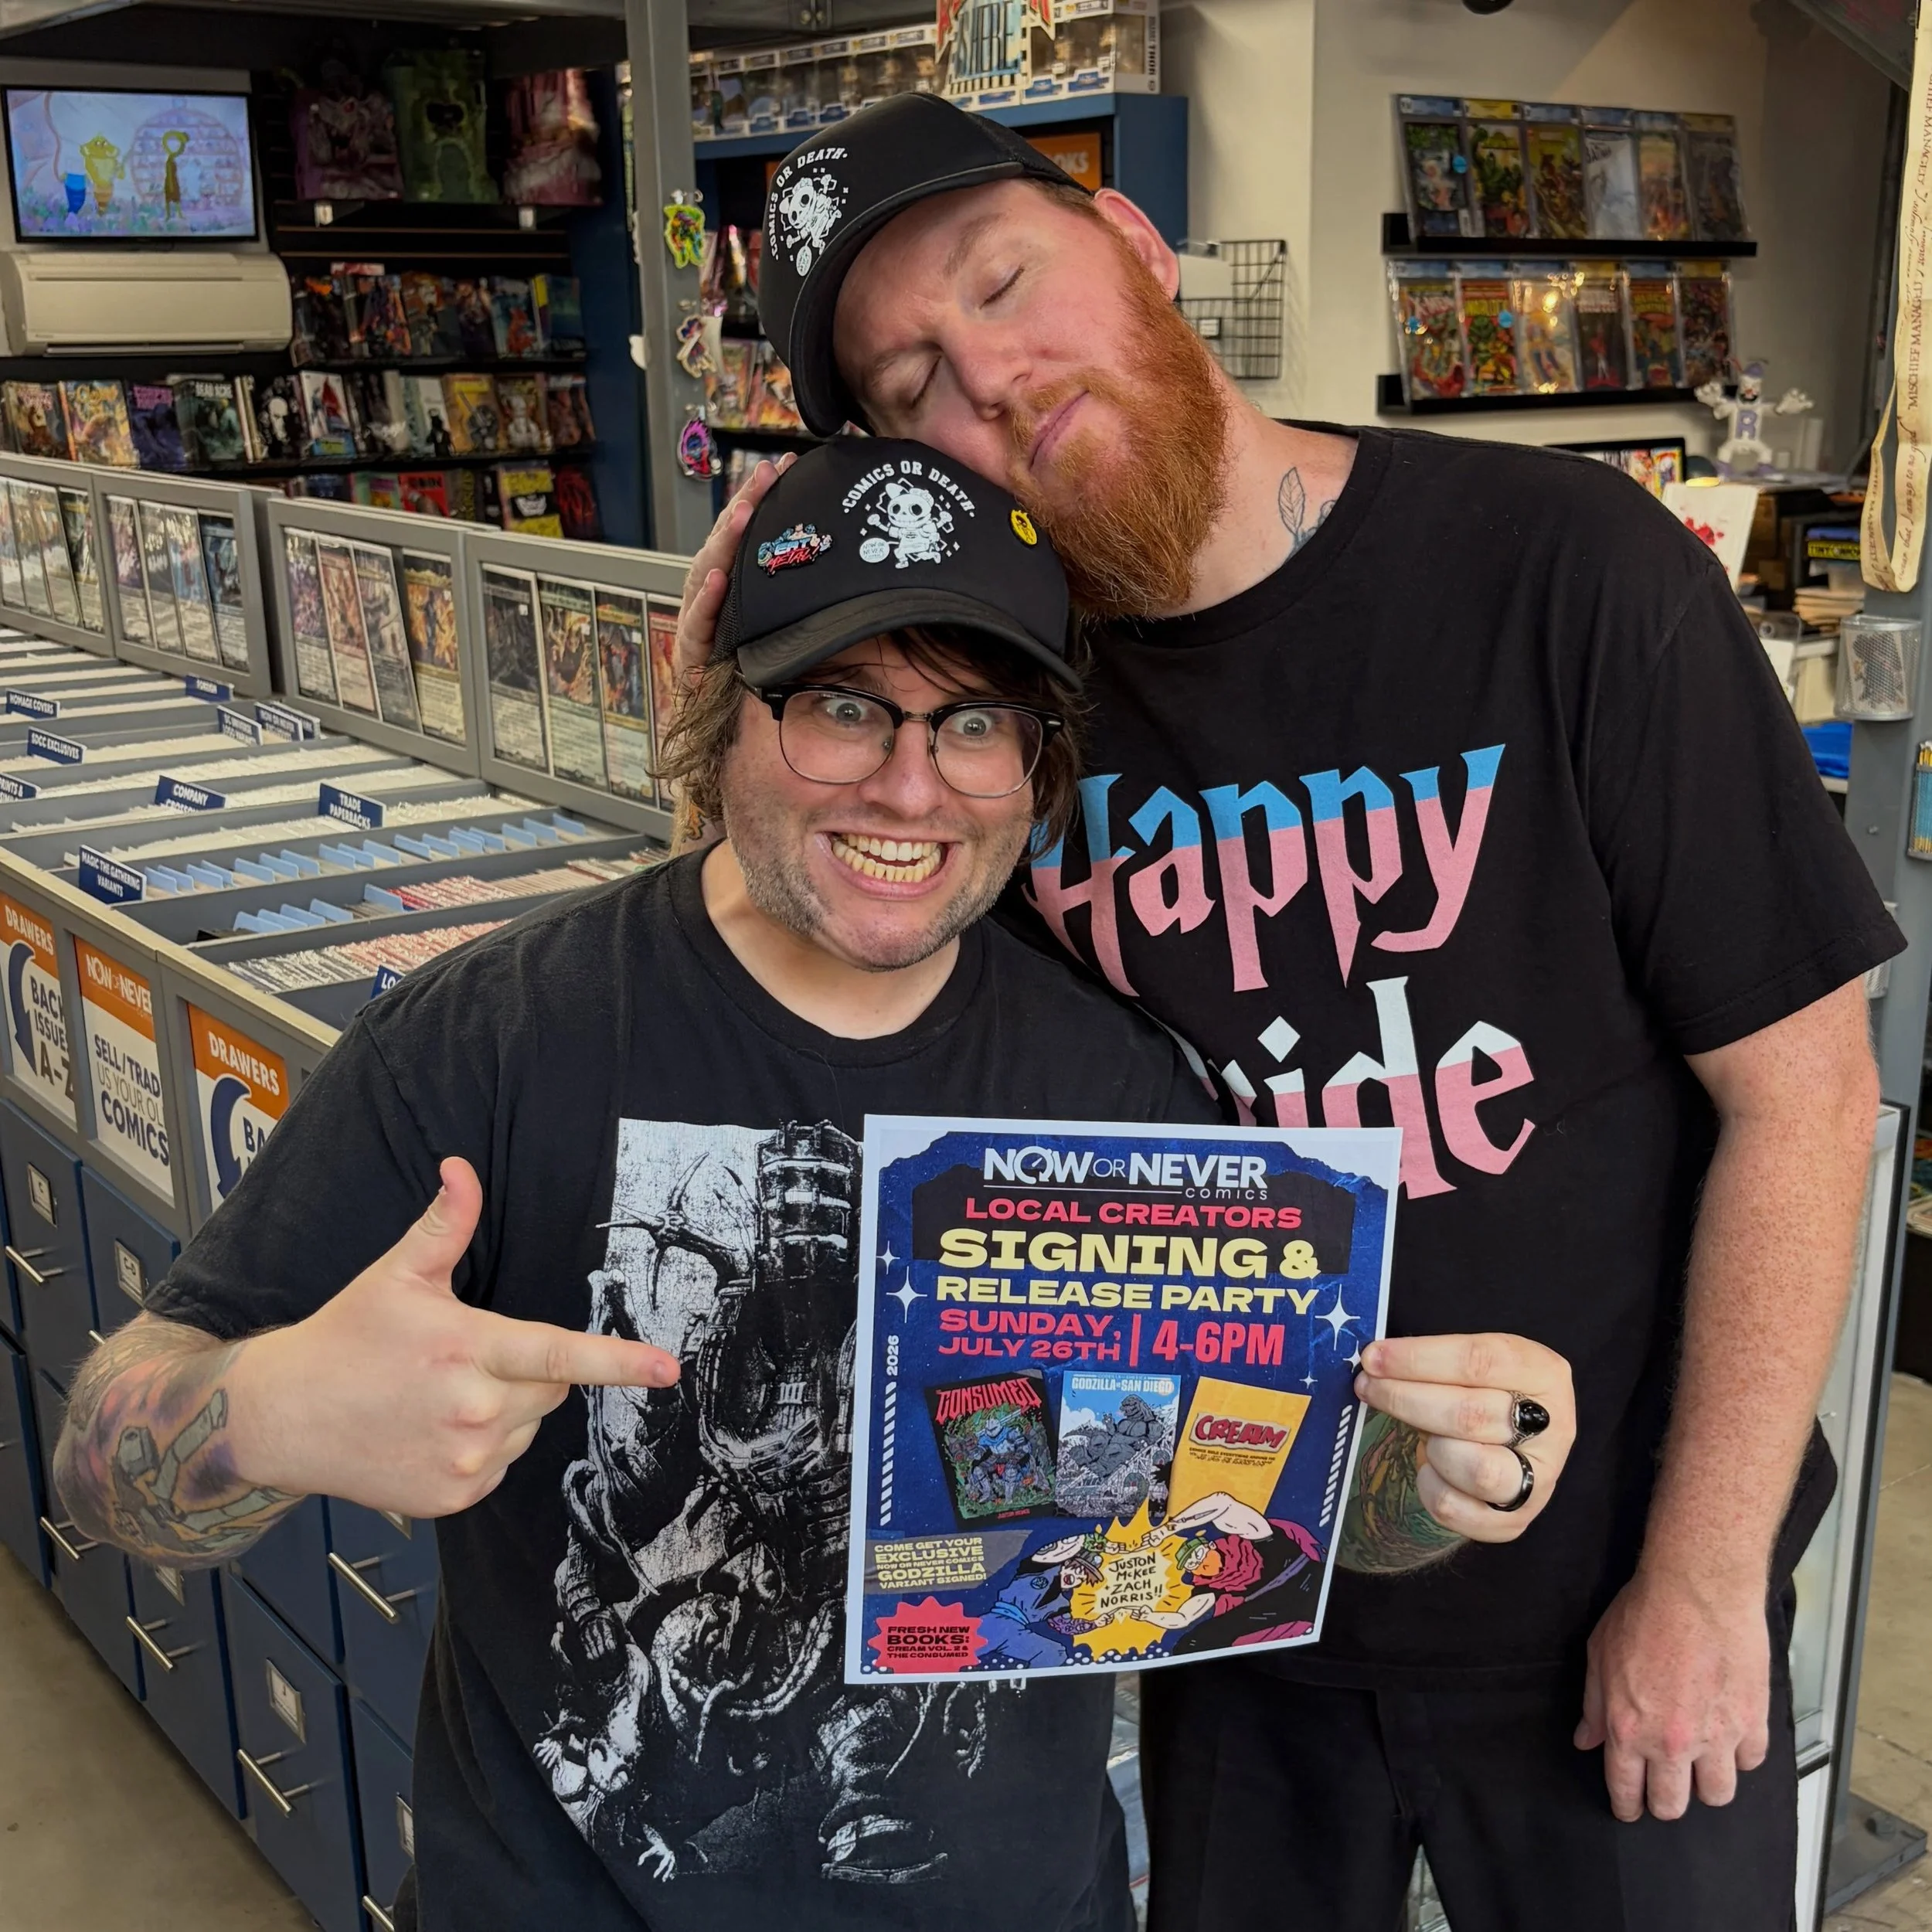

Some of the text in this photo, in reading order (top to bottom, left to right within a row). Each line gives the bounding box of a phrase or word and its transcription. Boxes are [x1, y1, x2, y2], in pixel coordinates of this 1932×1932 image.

[768, 192, 778, 257] COMICS
[776, 165, 794, 188] OR
[842, 464, 895, 508] COMICS
[900, 461, 923, 476] OR
[9, 695, 54, 715] HOMAGE COVERS
[31, 733, 80, 759] SDCC EXCLUSIVES
[172, 784, 209, 806] COMPANY
[339, 792, 361, 813] TRADE
[329, 802, 371, 831] PAPERBACKS
[81, 850, 141, 891] MAGIC THE GATHERING
[97, 873, 124, 897] VARIANTS
[1021, 743, 1505, 996] Happy
[5, 904, 54, 956] DRAWERS
[86, 953, 112, 991] NOW
[381, 972, 396, 990] LO
[34, 1009, 68, 1052] ISSUE
[94, 1033, 161, 1098] SELL/TRAD
[208, 1030, 281, 1097] DRAWERS
[97, 1060, 165, 1128] US YOUR OL
[1159, 976, 1536, 1199] ide
[101, 1090, 169, 1167] COMICS
[243, 1116, 266, 1153] BA
[983, 1145, 1267, 1189] NOW OR NEVER
[1185, 1187, 1268, 1201] comics
[965, 1198, 1302, 1229] LOCAL CREATORS
[938, 1227, 1321, 1280] SIGNING &
[936, 1276, 1319, 1315] RELEASE PARTY
[938, 1308, 1121, 1339] SUNDAY,
[886, 1335, 900, 1376] 2026
[938, 1338, 1121, 1361] JULY 26TH
[1152, 1319, 1286, 1366] 4-6PM
[1072, 1377, 1116, 1391] GODZILLA
[1121, 1378, 1142, 1392] SAN
[1143, 1380, 1172, 1393] DIEGO
[935, 1377, 1043, 1425] CONSUMED
[1195, 1415, 1287, 1449] CREAM
[874, 1537, 983, 1553] COME GET YOUR
[875, 1546, 984, 1563] EXCLUSIVE
[945, 1556, 985, 1565] COMICS
[877, 1563, 986, 1582] GODZILLA
[1108, 1552, 1156, 1573] JUSTON
[879, 1573, 987, 1590] VARIANT SIGNED!
[1100, 1583, 1163, 1608] NORRIS!!
[1111, 1579, 1151, 1595] ZACH
[887, 1634, 969, 1645] BOOKS:
